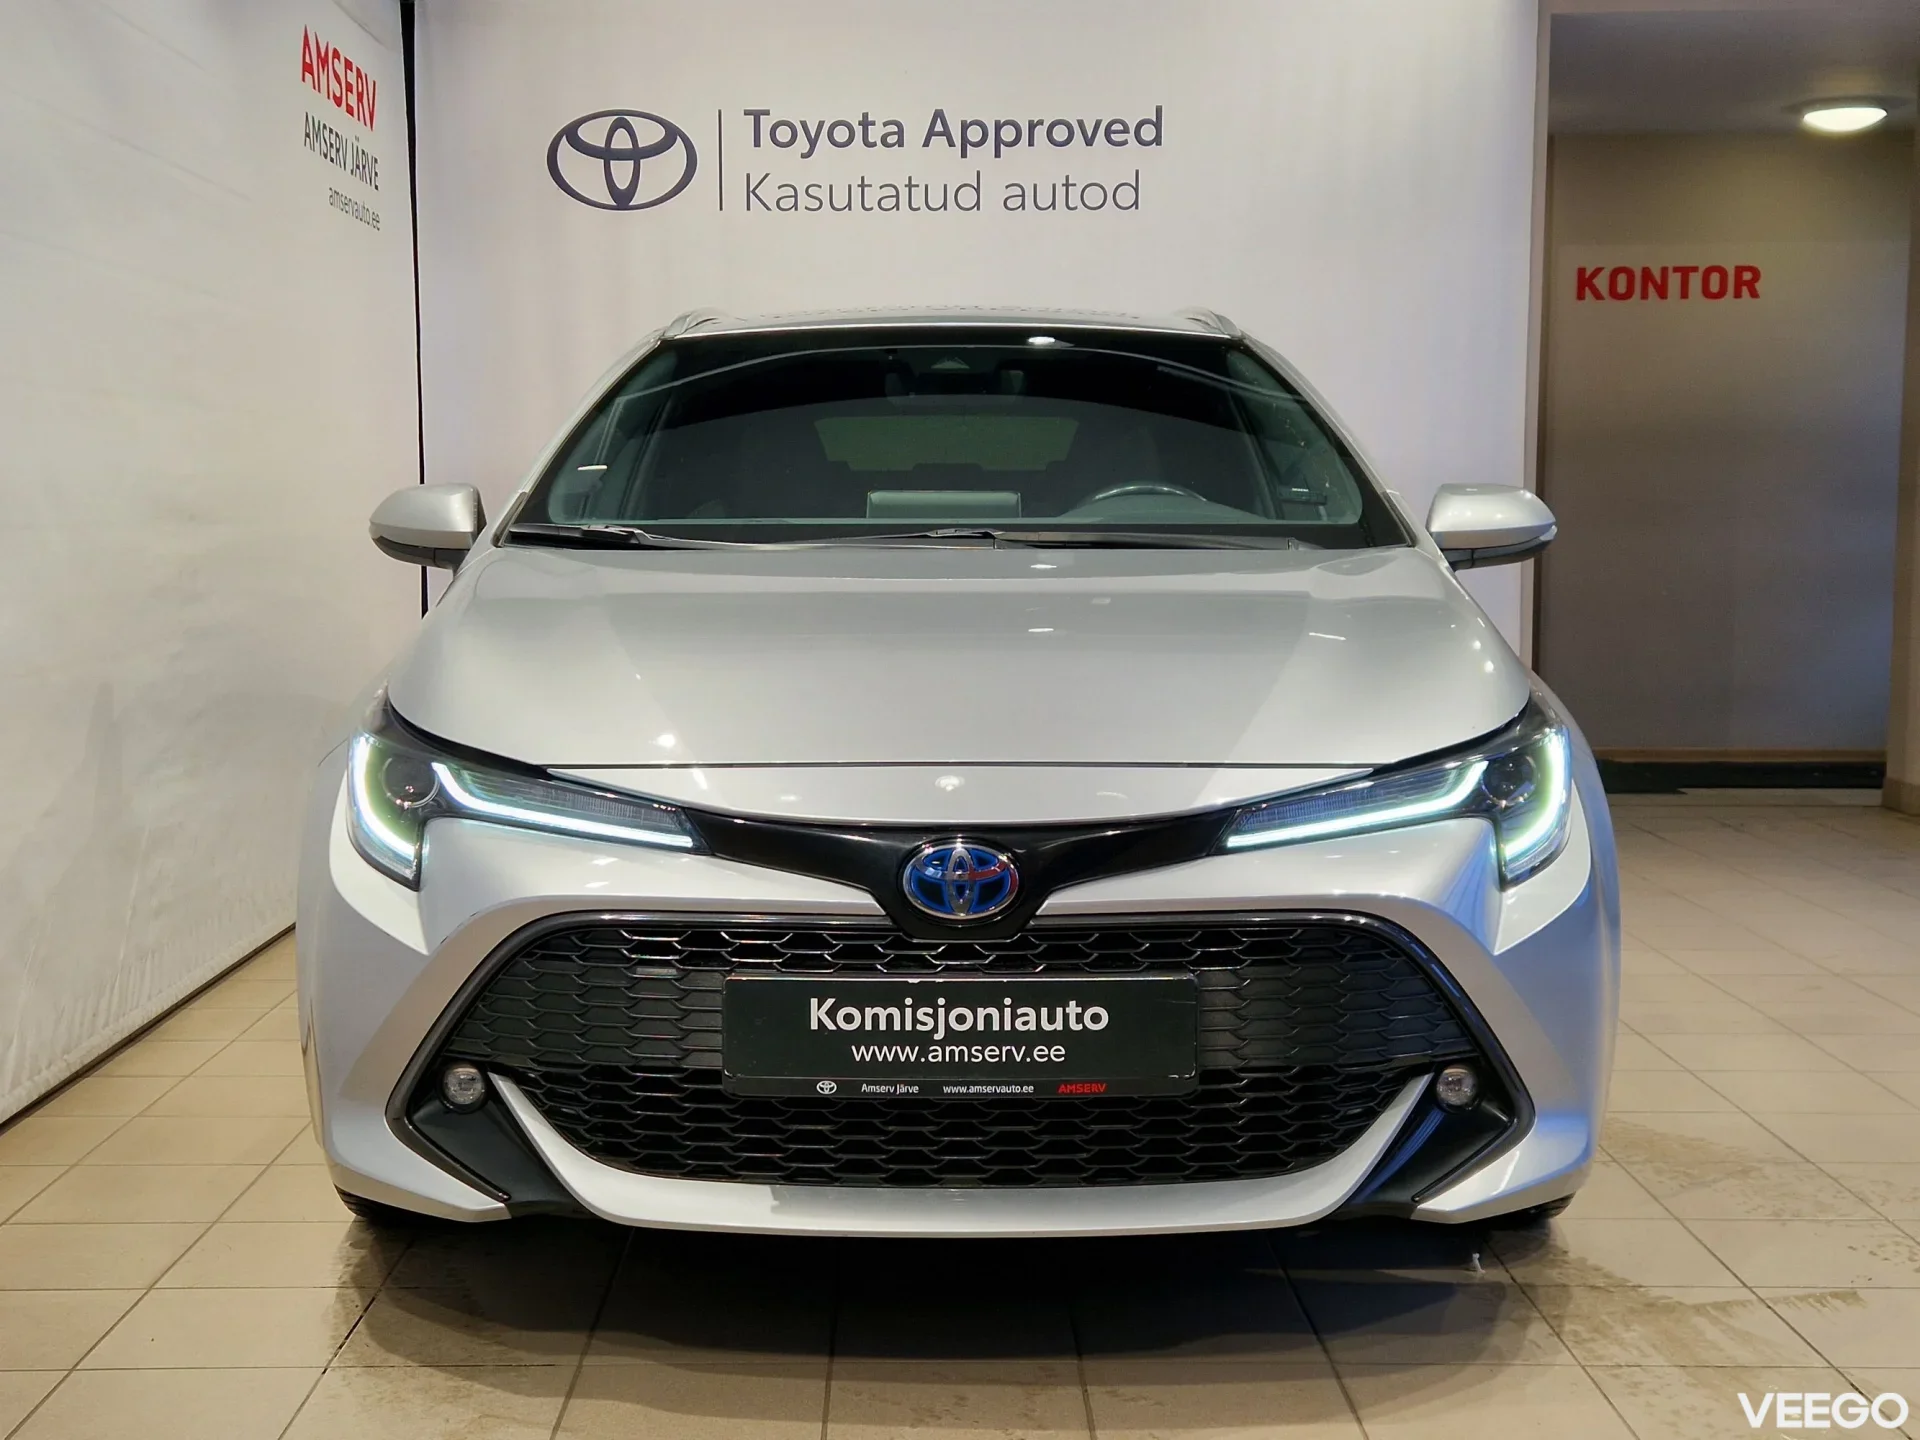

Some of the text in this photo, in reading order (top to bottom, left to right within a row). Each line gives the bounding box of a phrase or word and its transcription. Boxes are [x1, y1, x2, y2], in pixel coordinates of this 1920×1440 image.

[301, 24, 377, 132] AMSERV
[303, 112, 379, 191] AMSERV JÄRVE
[743, 105, 1165, 159] Toyota Approved
[328, 186, 381, 231] amservauto.ee
[745, 169, 1142, 212] Kasutatud autod
[1575, 264, 1762, 302] KONTOR
[810, 997, 1109, 1041] Komisjoniauto
[851, 1041, 1066, 1063] www.amserv.ee
[861, 1082, 1107, 1096] Amserv Järve www.amservauto.ee AMSERV
